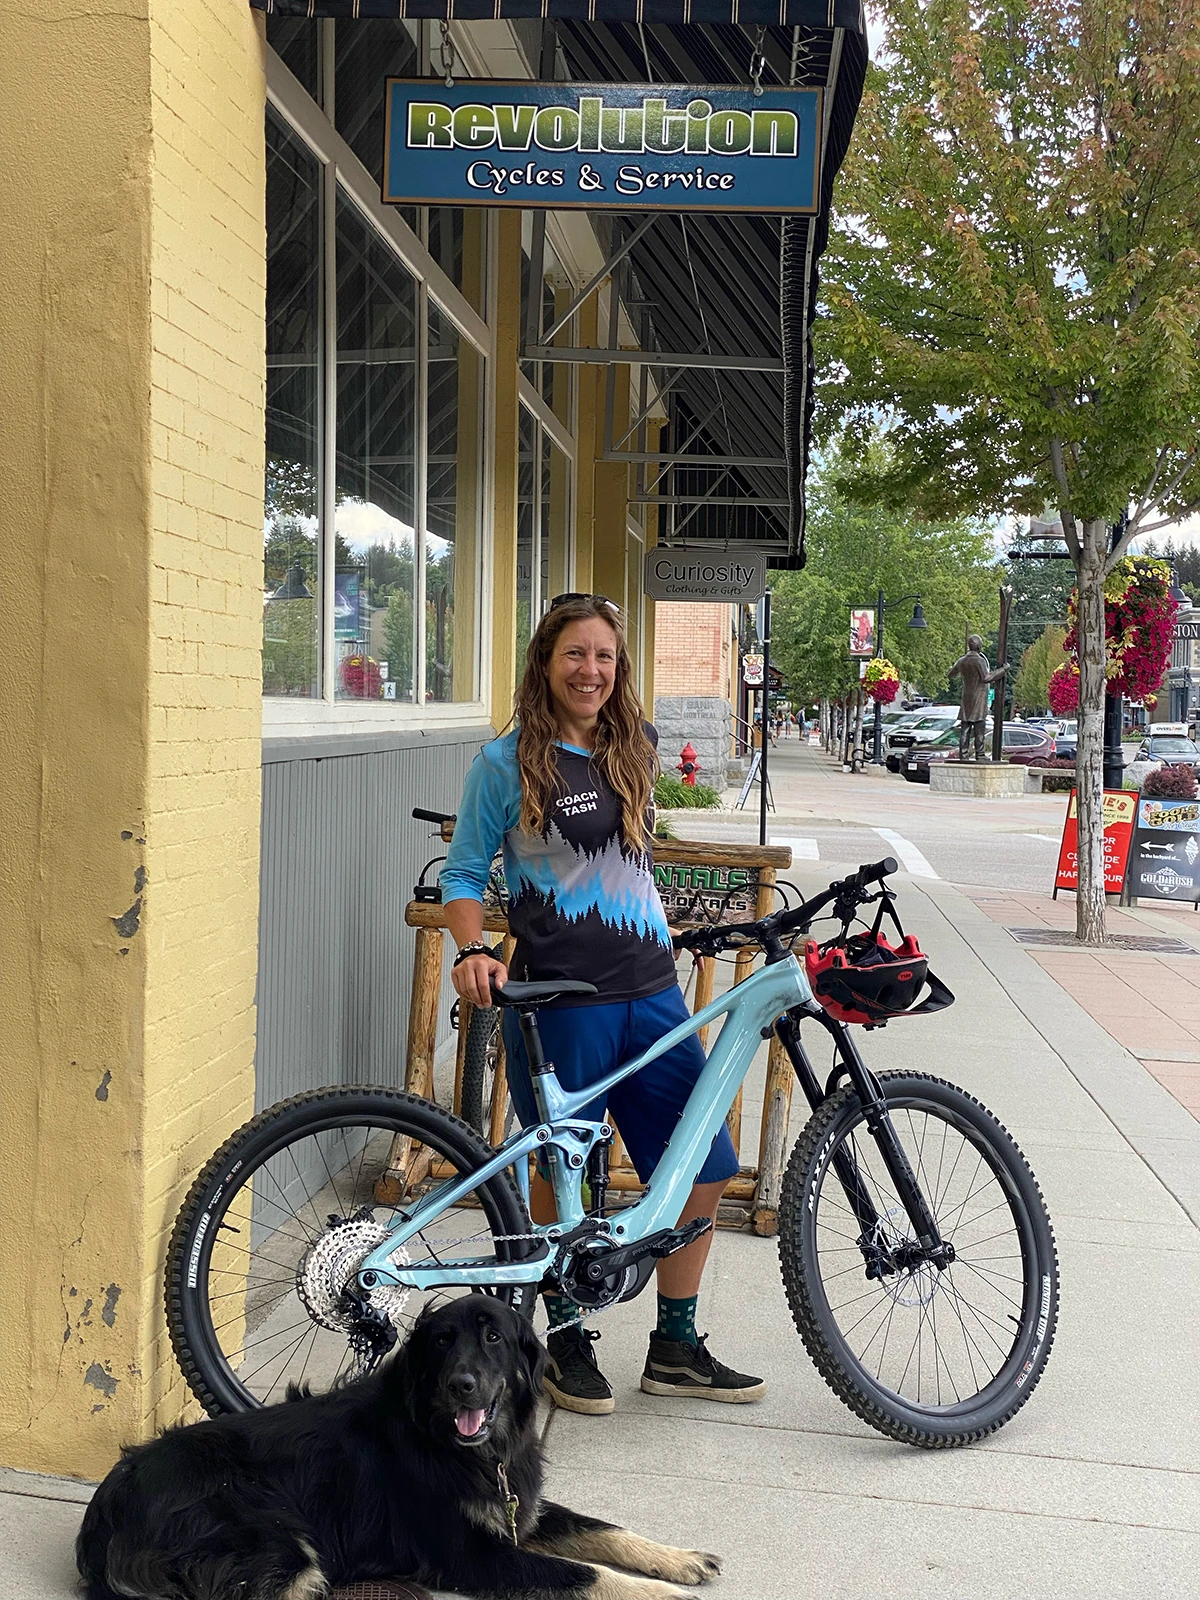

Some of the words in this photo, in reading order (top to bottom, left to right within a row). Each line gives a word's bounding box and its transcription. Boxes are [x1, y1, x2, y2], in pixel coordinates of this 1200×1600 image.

[466, 161, 564, 194] Cycles
[578, 166, 604, 192] &
[615, 165, 735, 195] Service
[655, 560, 755, 588] Curiosity
[665, 585, 710, 596] Clothing
[720, 586, 743, 596] Gifts
[556, 791, 598, 807] COACH
[1103, 796, 1128, 811] IE'S
[562, 802, 597, 816] TASH
[653, 866, 748, 891] NTALS
[1140, 873, 1165, 884] GOLD
[1168, 876, 1194, 887] RUSH
[807, 1131, 836, 1213] MAXXIS
